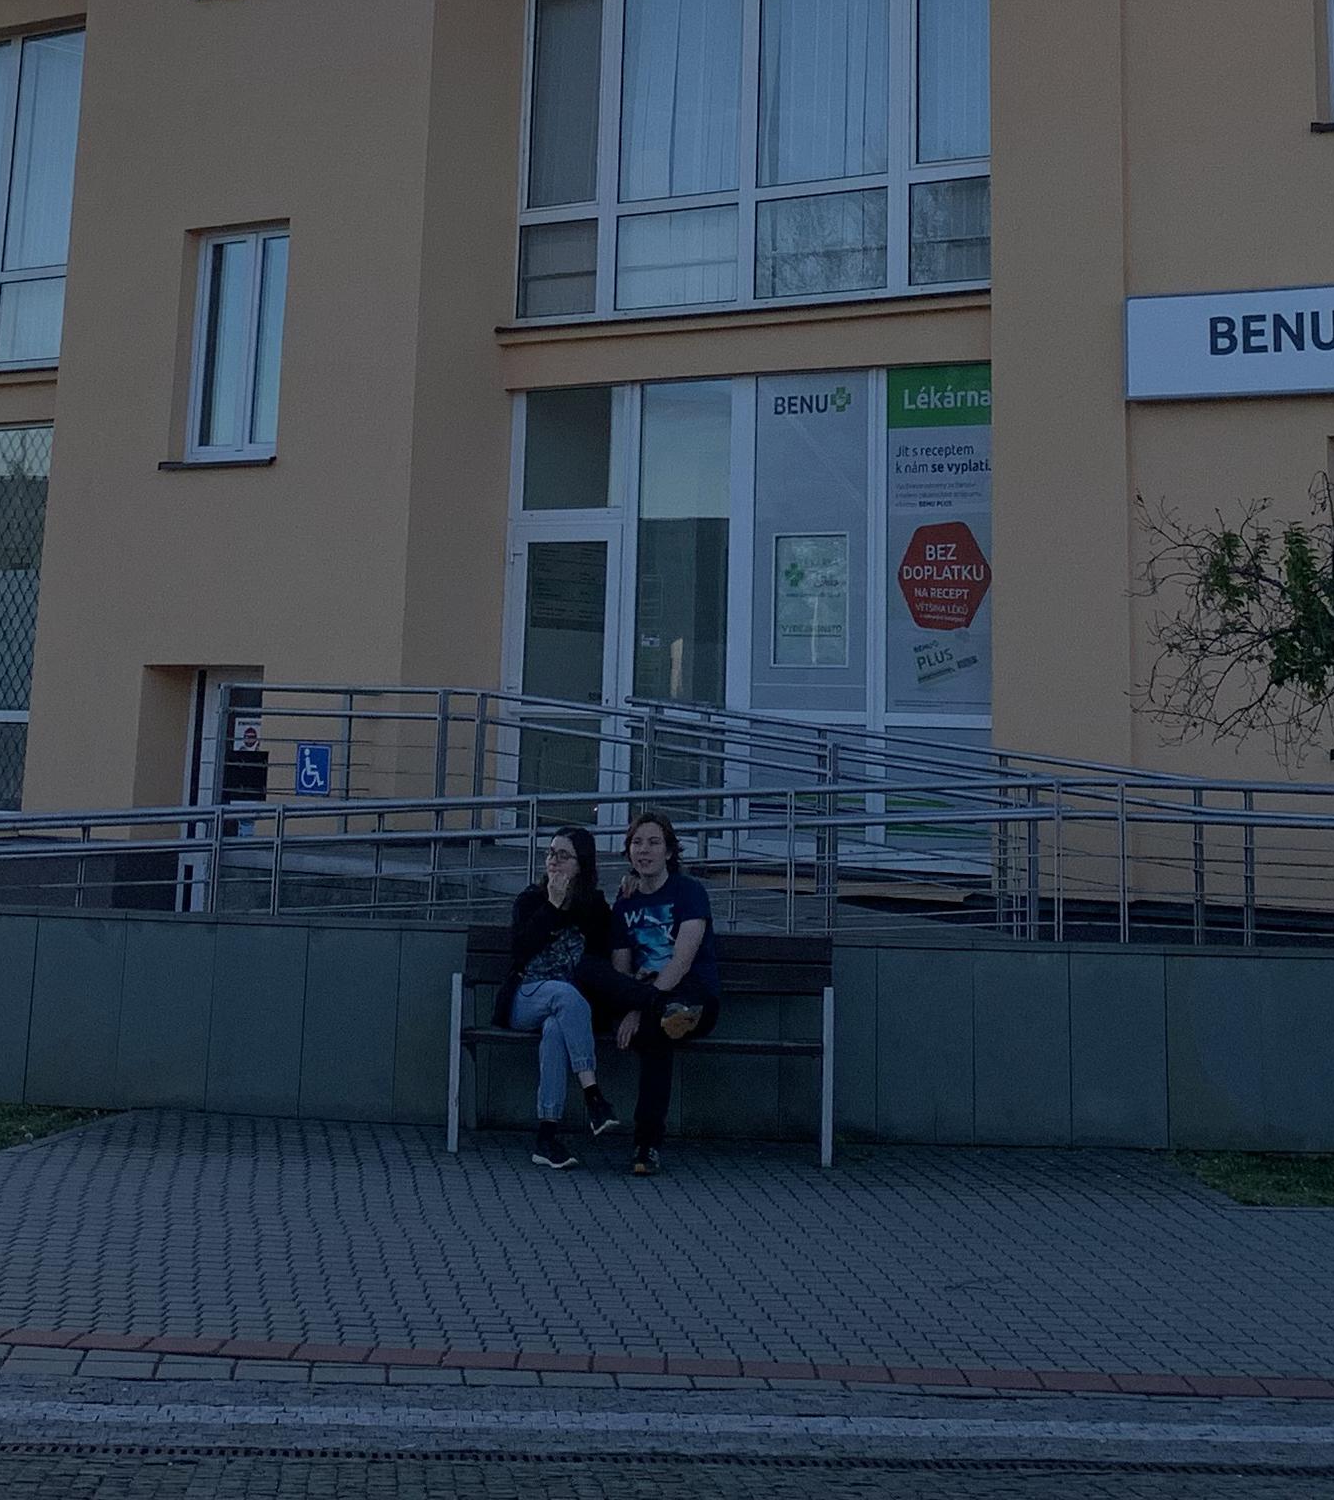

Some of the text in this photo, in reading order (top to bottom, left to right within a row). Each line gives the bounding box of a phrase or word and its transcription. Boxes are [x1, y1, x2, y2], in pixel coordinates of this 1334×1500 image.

[773, 393, 829, 415] BENU
[903, 384, 992, 410] Lékárna
[912, 447, 919, 457] s
[920, 444, 974, 458] receptem
[895, 461, 902, 473] k
[904, 461, 929, 473] nám
[931, 462, 944, 473] se
[925, 543, 957, 561] BEZ
[902, 564, 985, 581] DOPLATKU
[914, 587, 970, 599] NA RECEPT
[916, 648, 954, 670] PLUS
